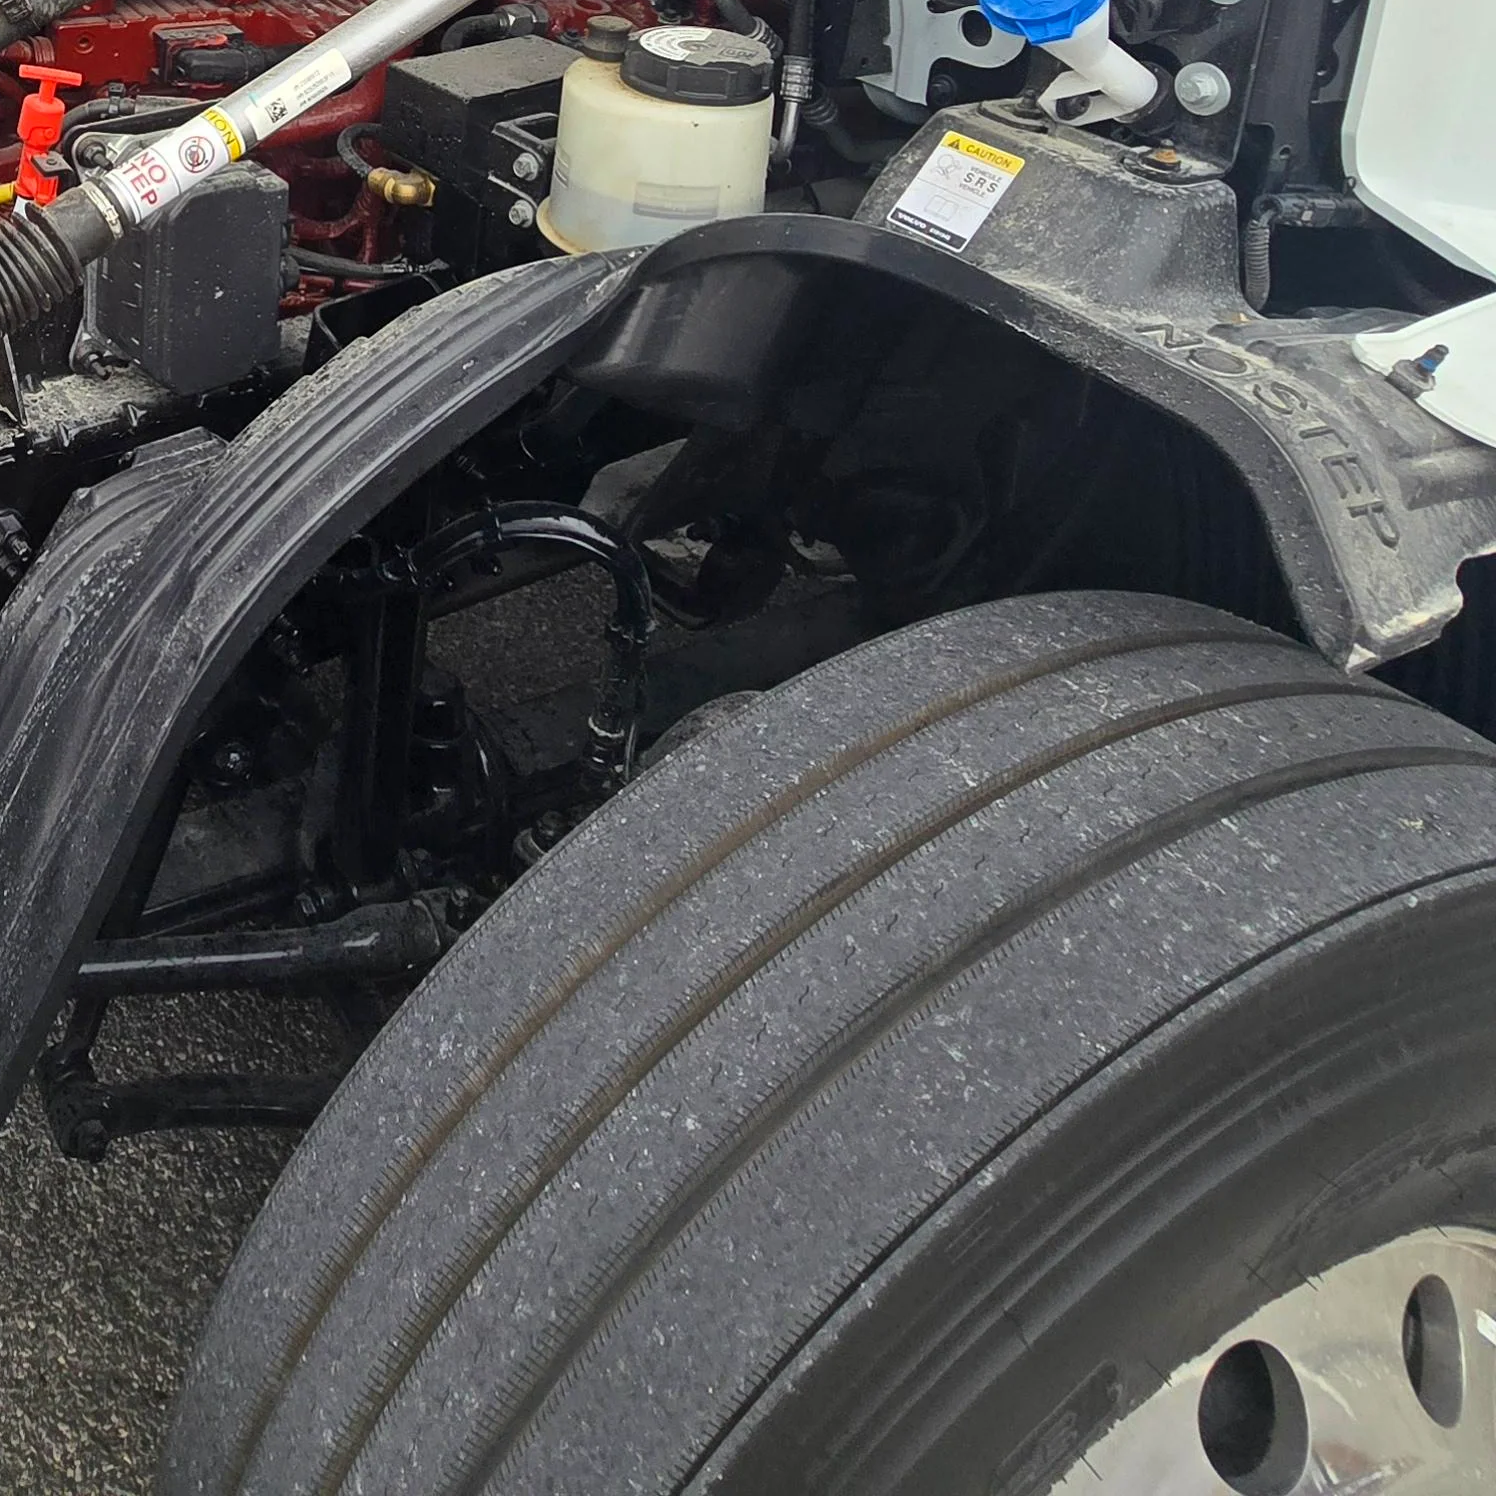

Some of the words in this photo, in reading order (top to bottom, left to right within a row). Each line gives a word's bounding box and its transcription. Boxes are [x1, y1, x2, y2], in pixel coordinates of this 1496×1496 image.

[138, 150, 167, 186] NO
[966, 145, 1012, 168] CAUTION
[959, 183, 986, 198] VEHICLE
[898, 212, 926, 229] VOLVO
[1135, 323, 1251, 377] NO
[1252, 381, 1402, 549] STEP
